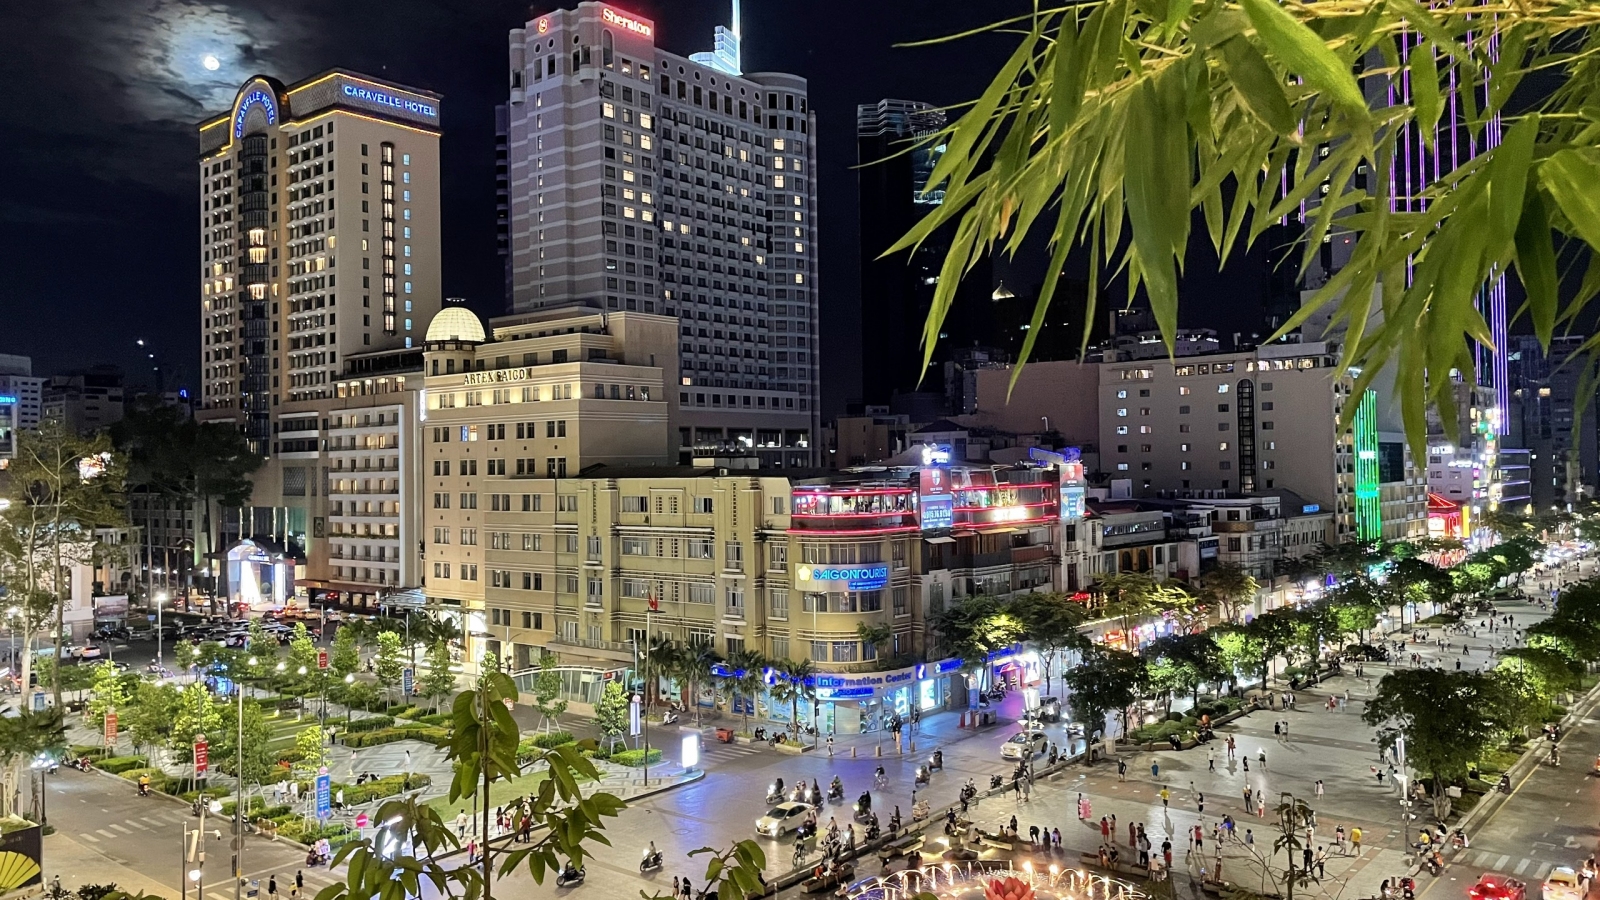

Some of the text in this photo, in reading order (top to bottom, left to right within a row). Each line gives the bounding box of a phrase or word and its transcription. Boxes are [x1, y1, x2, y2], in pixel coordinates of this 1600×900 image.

[602, 8, 651, 36] Sheraton
[261, 94, 275, 125] HOTEL
[344, 86, 436, 116] CARAVELLE HOTEL
[464, 371, 495, 385] ARTEX
[813, 566, 887, 580] SAIGONTOURIST
[817, 674, 883, 687] Information
[885, 672, 912, 683] Center
